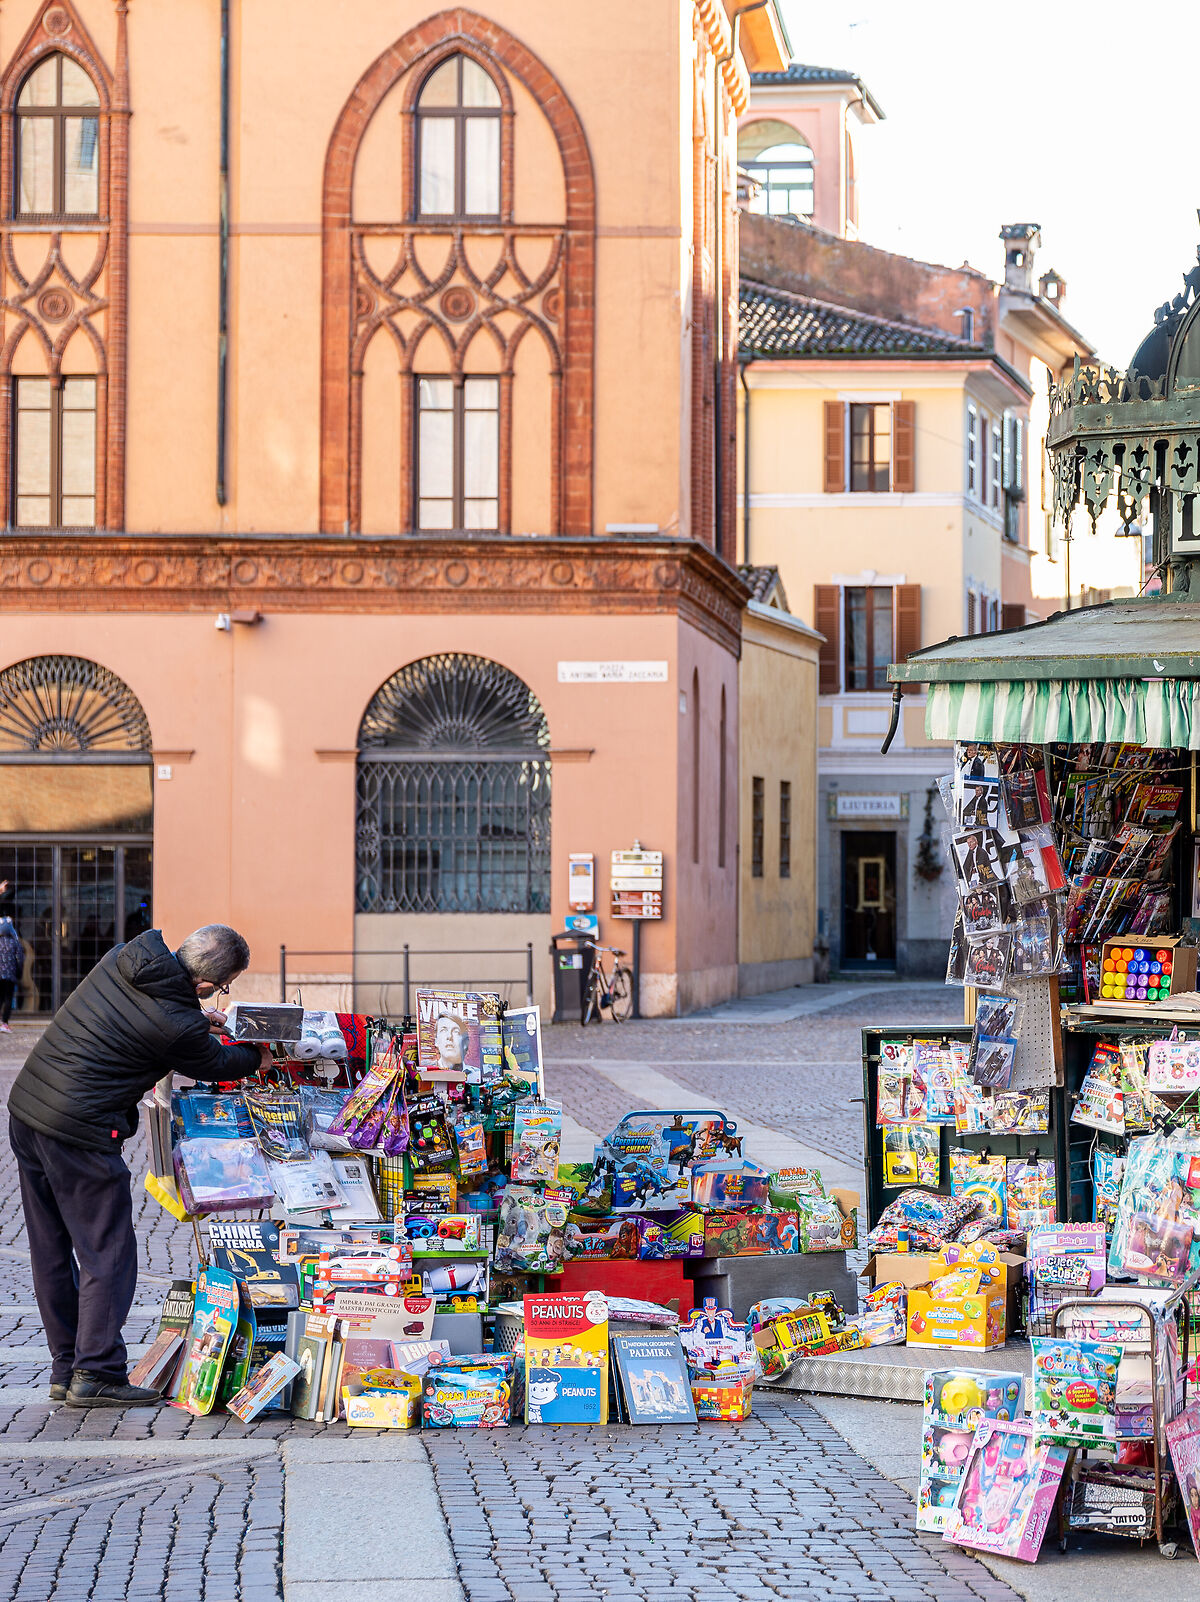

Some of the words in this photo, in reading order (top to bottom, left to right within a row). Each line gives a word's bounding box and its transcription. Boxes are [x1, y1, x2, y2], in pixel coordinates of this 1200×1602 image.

[1151, 793, 1179, 805] ZAGOR
[420, 1000, 479, 1022] VINILE
[419, 1101, 438, 1110] RAY
[1086, 1095, 1107, 1107] NATALE
[252, 1106, 297, 1122] Minerali
[613, 1137, 649, 1146] PREDATORI
[625, 1145, 651, 1154] GHIACCI
[424, 1202, 441, 1210] RAY
[209, 1224, 262, 1239] CHINE
[1065, 1223, 1105, 1232] MAGICO
[224, 1239, 265, 1249] TERRA
[163, 1300, 194, 1319] FANTASTICO
[531, 1305, 584, 1319] PEANUTS
[926, 1311, 965, 1320] cartoonito
[630, 1349, 672, 1357] PALMIRA
[437, 1391, 463, 1403] OCEAN
[561, 1388, 597, 1397] PEANUTS
[1114, 1514, 1144, 1524] TATTOO
[1025, 1513, 1038, 1542] Dolce
